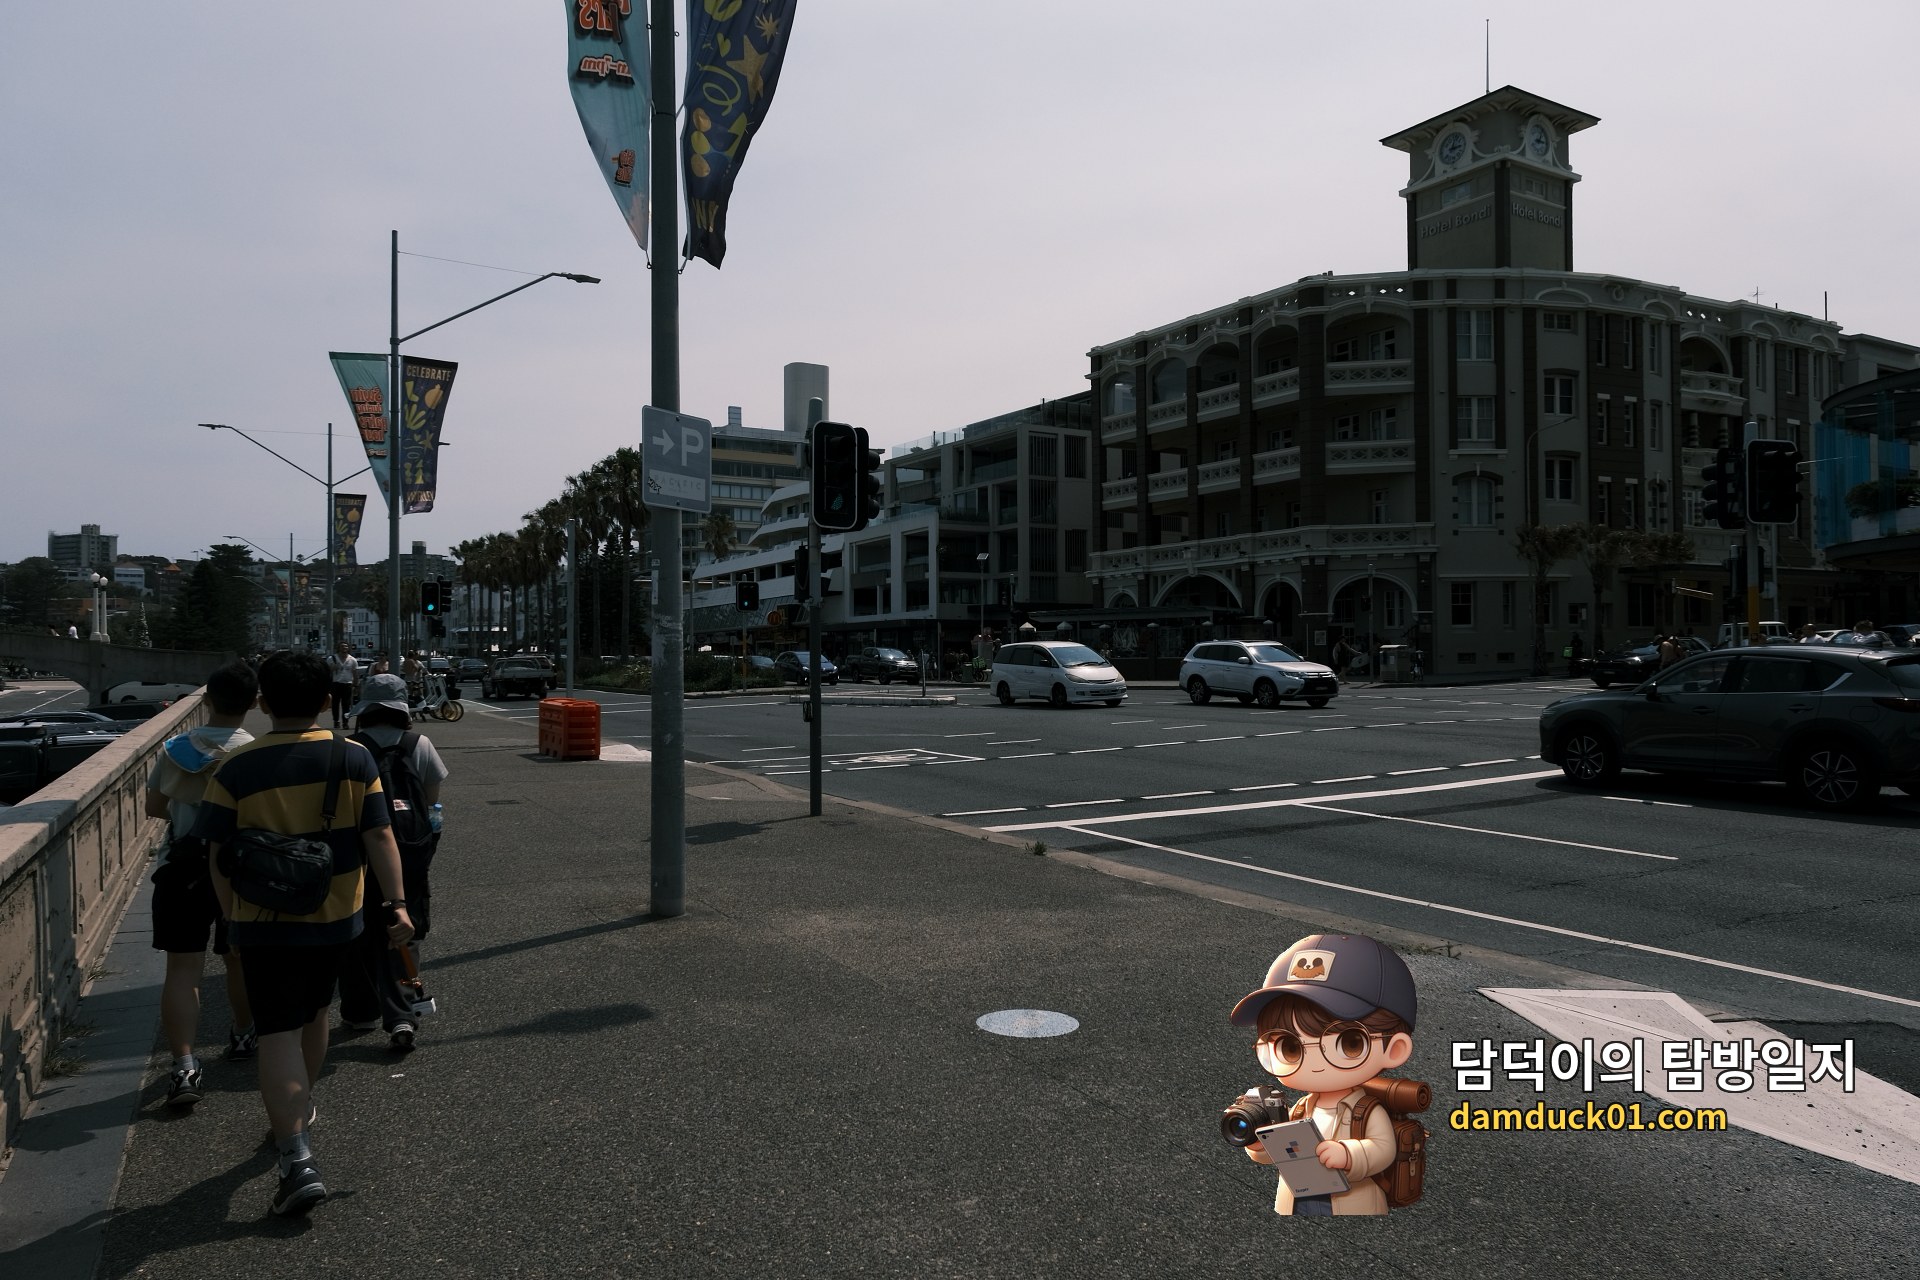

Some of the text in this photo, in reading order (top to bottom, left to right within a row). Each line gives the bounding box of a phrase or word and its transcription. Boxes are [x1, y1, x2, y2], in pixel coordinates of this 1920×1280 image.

[1420, 204, 1491, 239] Hotel Bondi
[1512, 202, 1563, 227] Hotel Bondi
[405, 364, 452, 382] CELEBRATE
[681, 427, 704, 467] P
